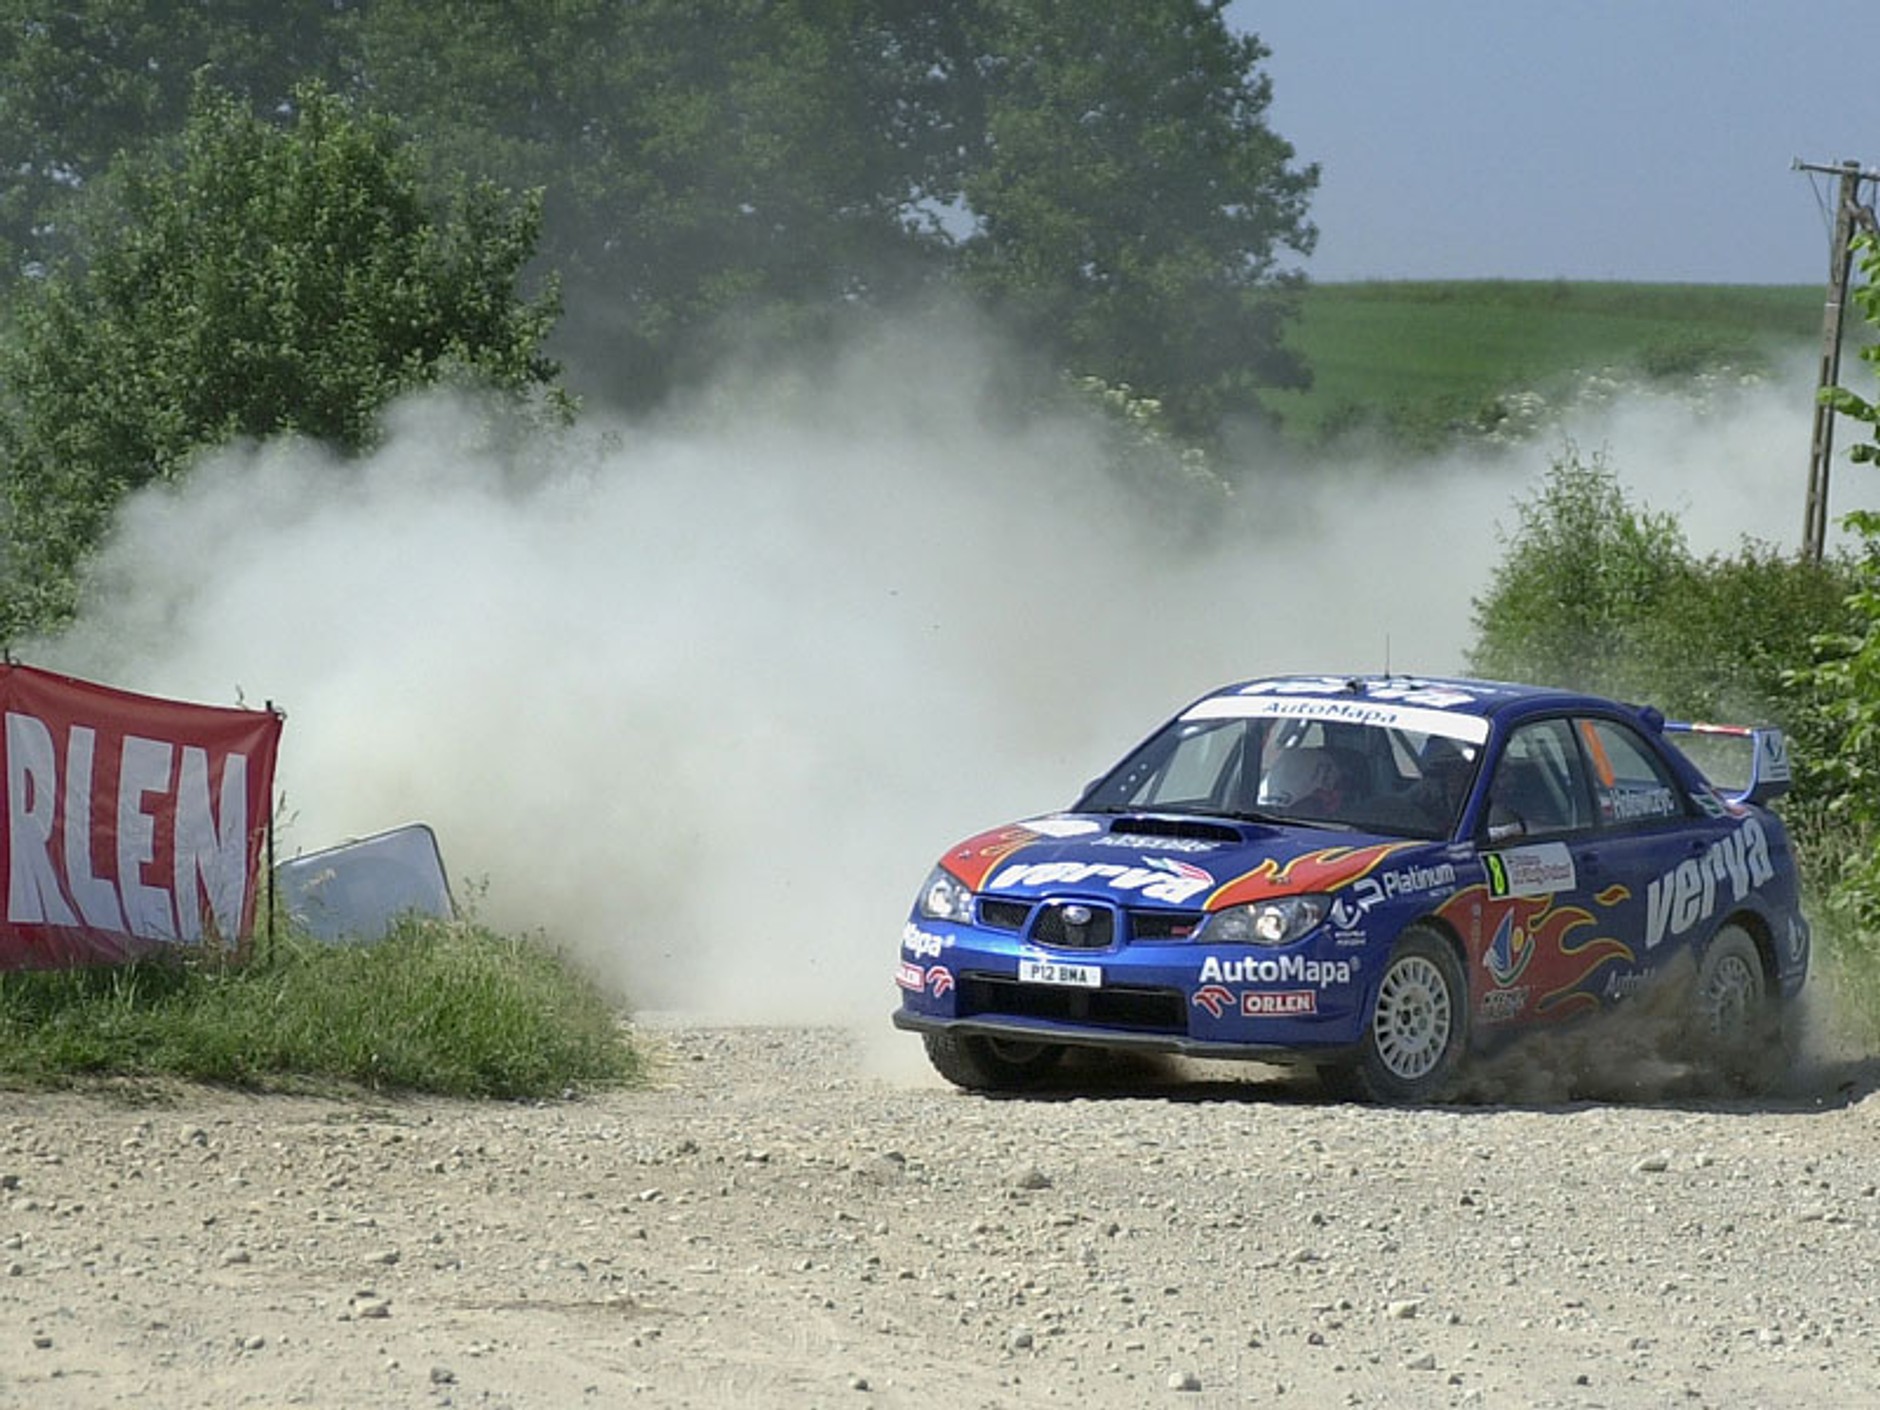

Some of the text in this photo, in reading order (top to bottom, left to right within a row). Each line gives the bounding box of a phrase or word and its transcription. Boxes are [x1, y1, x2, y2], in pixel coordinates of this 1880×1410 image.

[1262, 702, 1398, 725] AutoMapa
[4, 711, 249, 951] RLEN
[1382, 862, 1456, 899] Platinum
[1487, 854, 1505, 895] 8
[1646, 817, 1775, 949] verva
[1031, 964, 1088, 983] P12 BMA
[1245, 993, 1311, 1013] ORLEN
